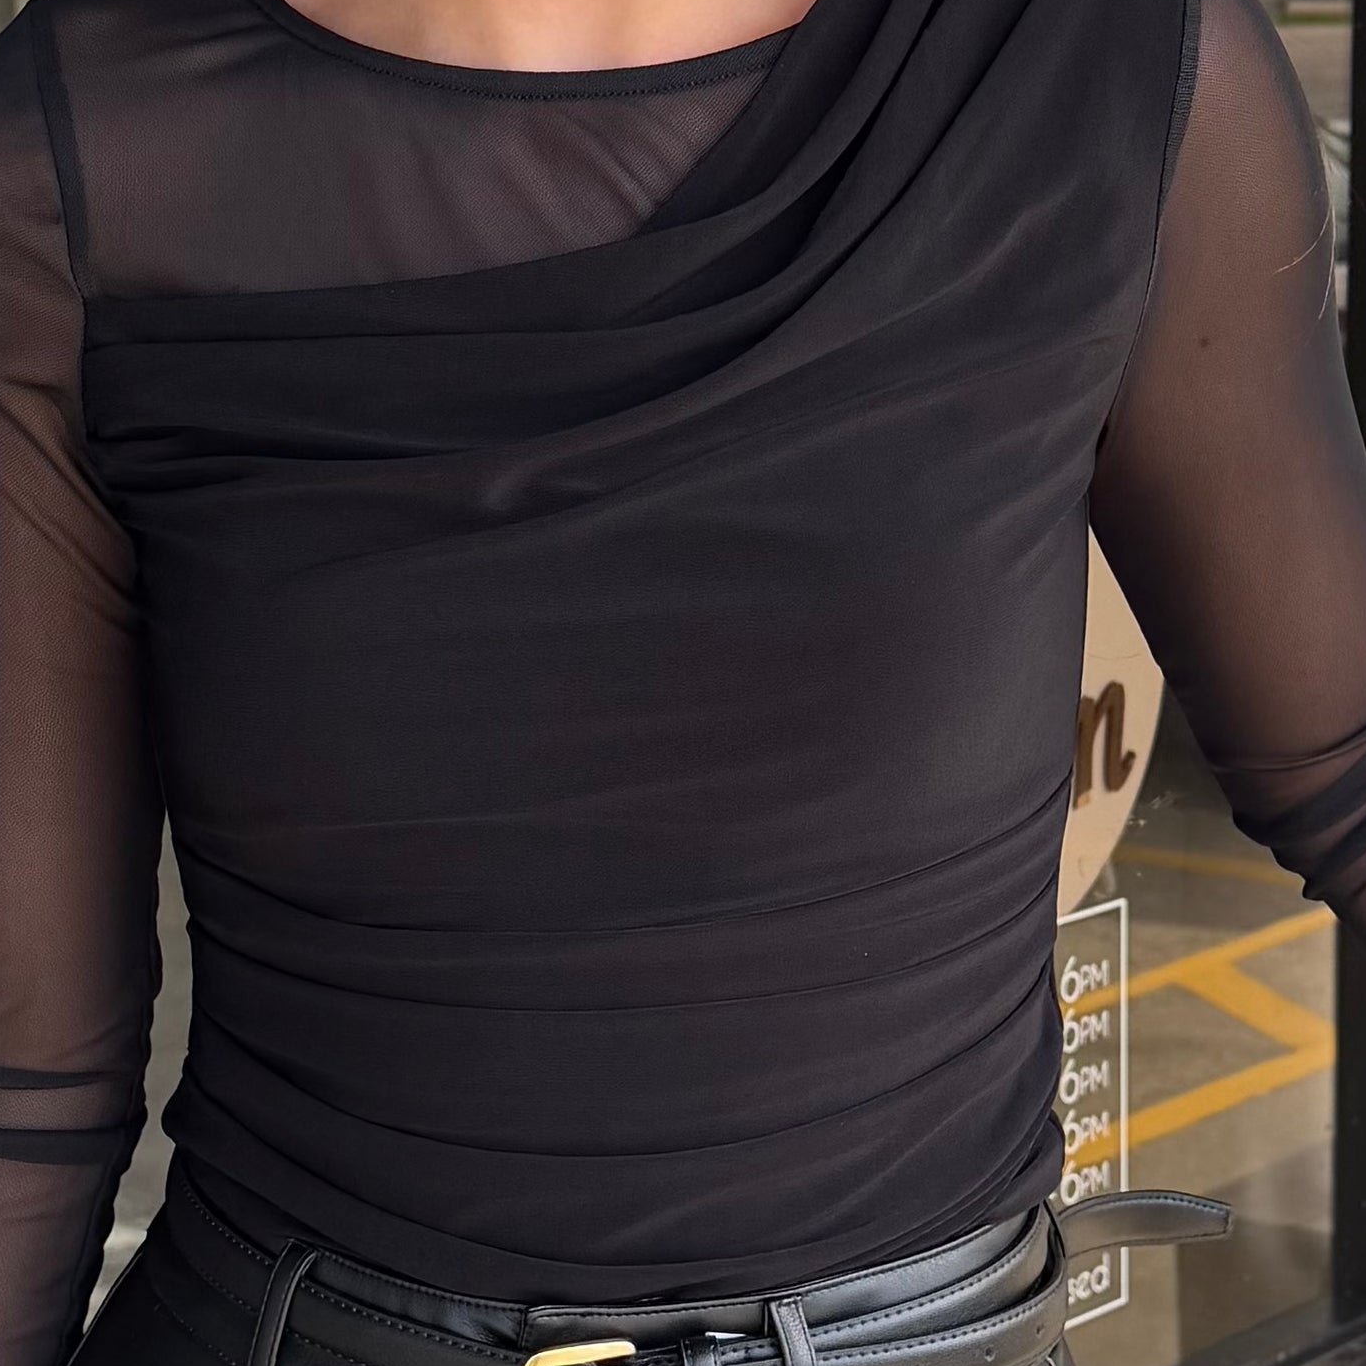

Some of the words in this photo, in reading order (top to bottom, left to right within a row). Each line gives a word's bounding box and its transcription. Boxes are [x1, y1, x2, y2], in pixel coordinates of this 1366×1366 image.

[1060, 955, 1110, 1004] 6PM
[1063, 1007, 1110, 1054] 6PM
[1059, 1057, 1110, 1105] 6PM
[1064, 1108, 1110, 1156] 6PM
